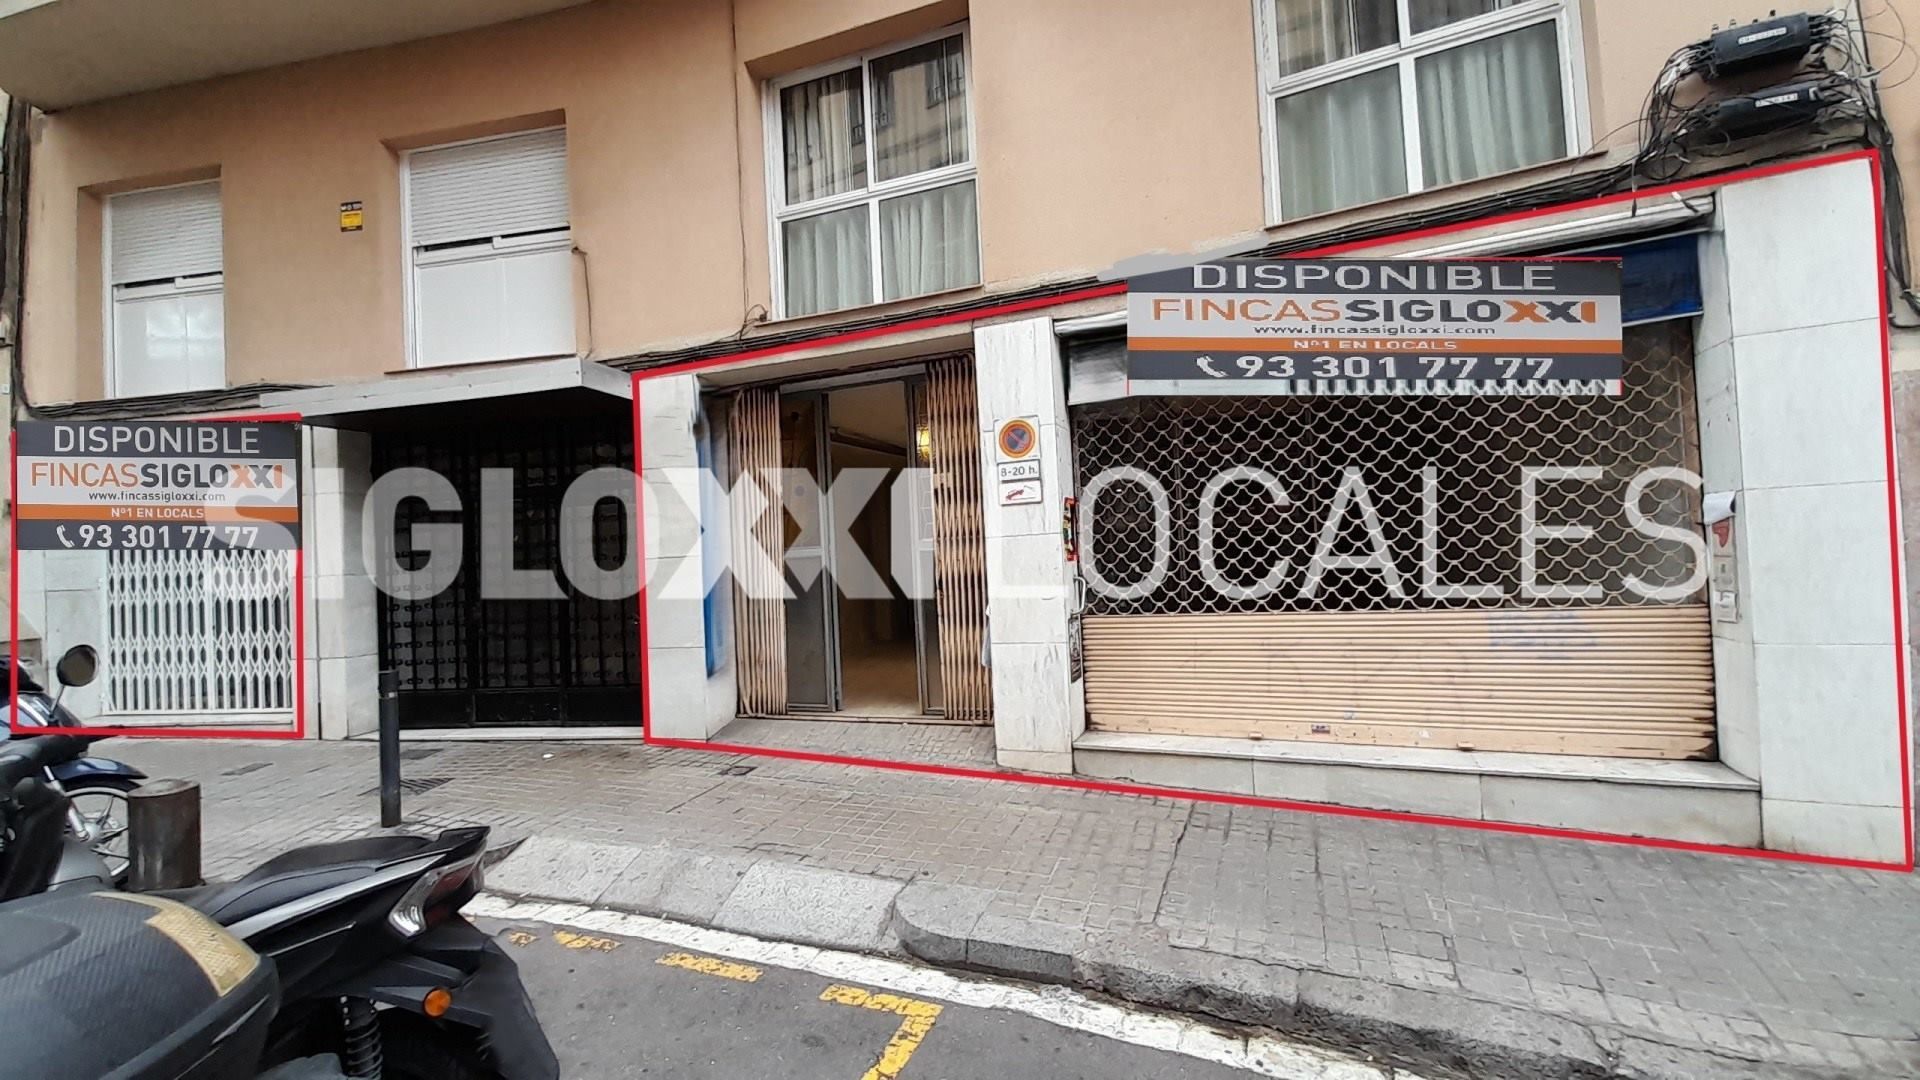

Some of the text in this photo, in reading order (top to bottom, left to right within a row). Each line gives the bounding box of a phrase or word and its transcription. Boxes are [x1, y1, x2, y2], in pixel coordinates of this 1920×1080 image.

[1193, 264, 1556, 290] DISPONIBLE
[1152, 298, 1596, 323] FINCASSIGLOXXI
[1254, 324, 1496, 336] www.fincassigloxxi.com
[1338, 341, 1368, 350] EN
[1374, 341, 1457, 350] LOCALS
[1236, 355, 1554, 379] 93 301 77 77
[54, 425, 260, 454] DISPONIBLE
[31, 462, 283, 489] FINCASSIGLOXXI
[1000, 466, 1025, 477] 8-20
[89, 490, 226, 503] www.fincassigloxxi.com
[137, 508, 153, 518] EN
[157, 508, 204, 519] LOCALS
[79, 524, 259, 548] 93 301 77 77
